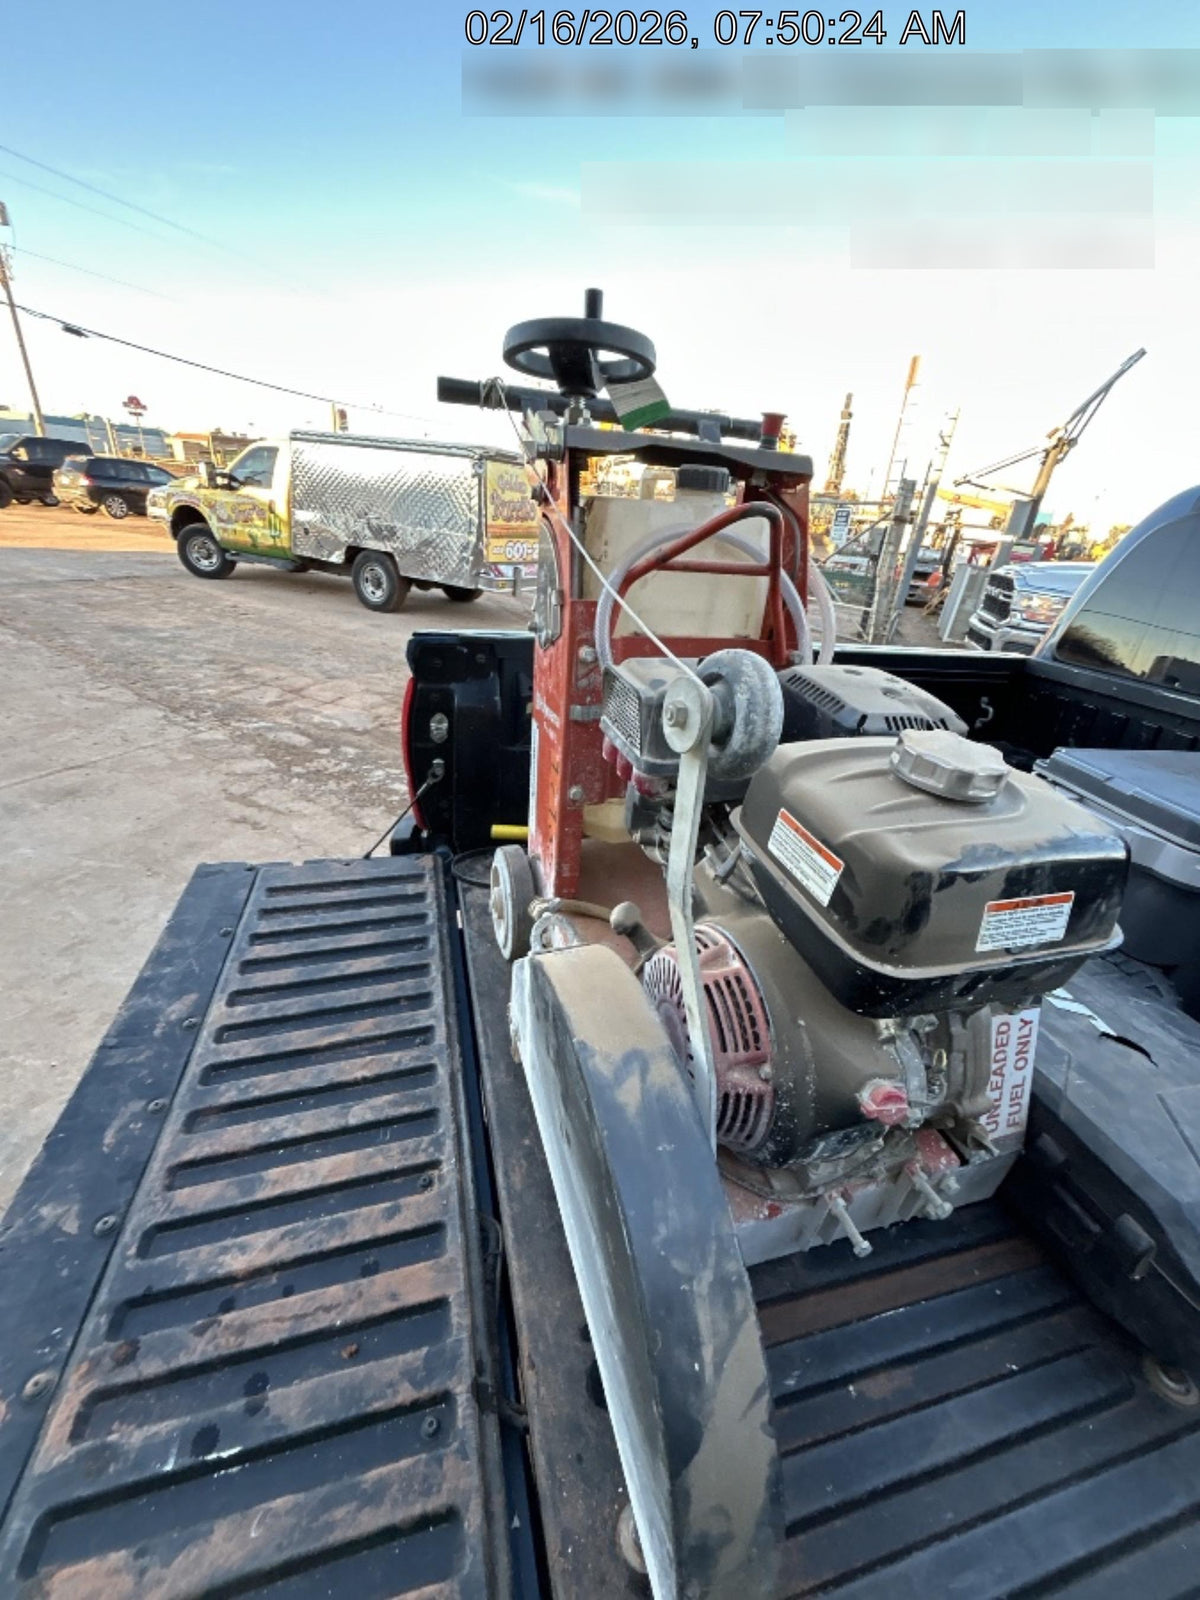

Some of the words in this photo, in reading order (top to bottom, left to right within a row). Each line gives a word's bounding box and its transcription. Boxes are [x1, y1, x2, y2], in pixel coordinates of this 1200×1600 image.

[1013, 1018, 1034, 1071] ONLY
[986, 1021, 1011, 1133] UNLEADED
[1006, 1075, 1027, 1128] FUEL
